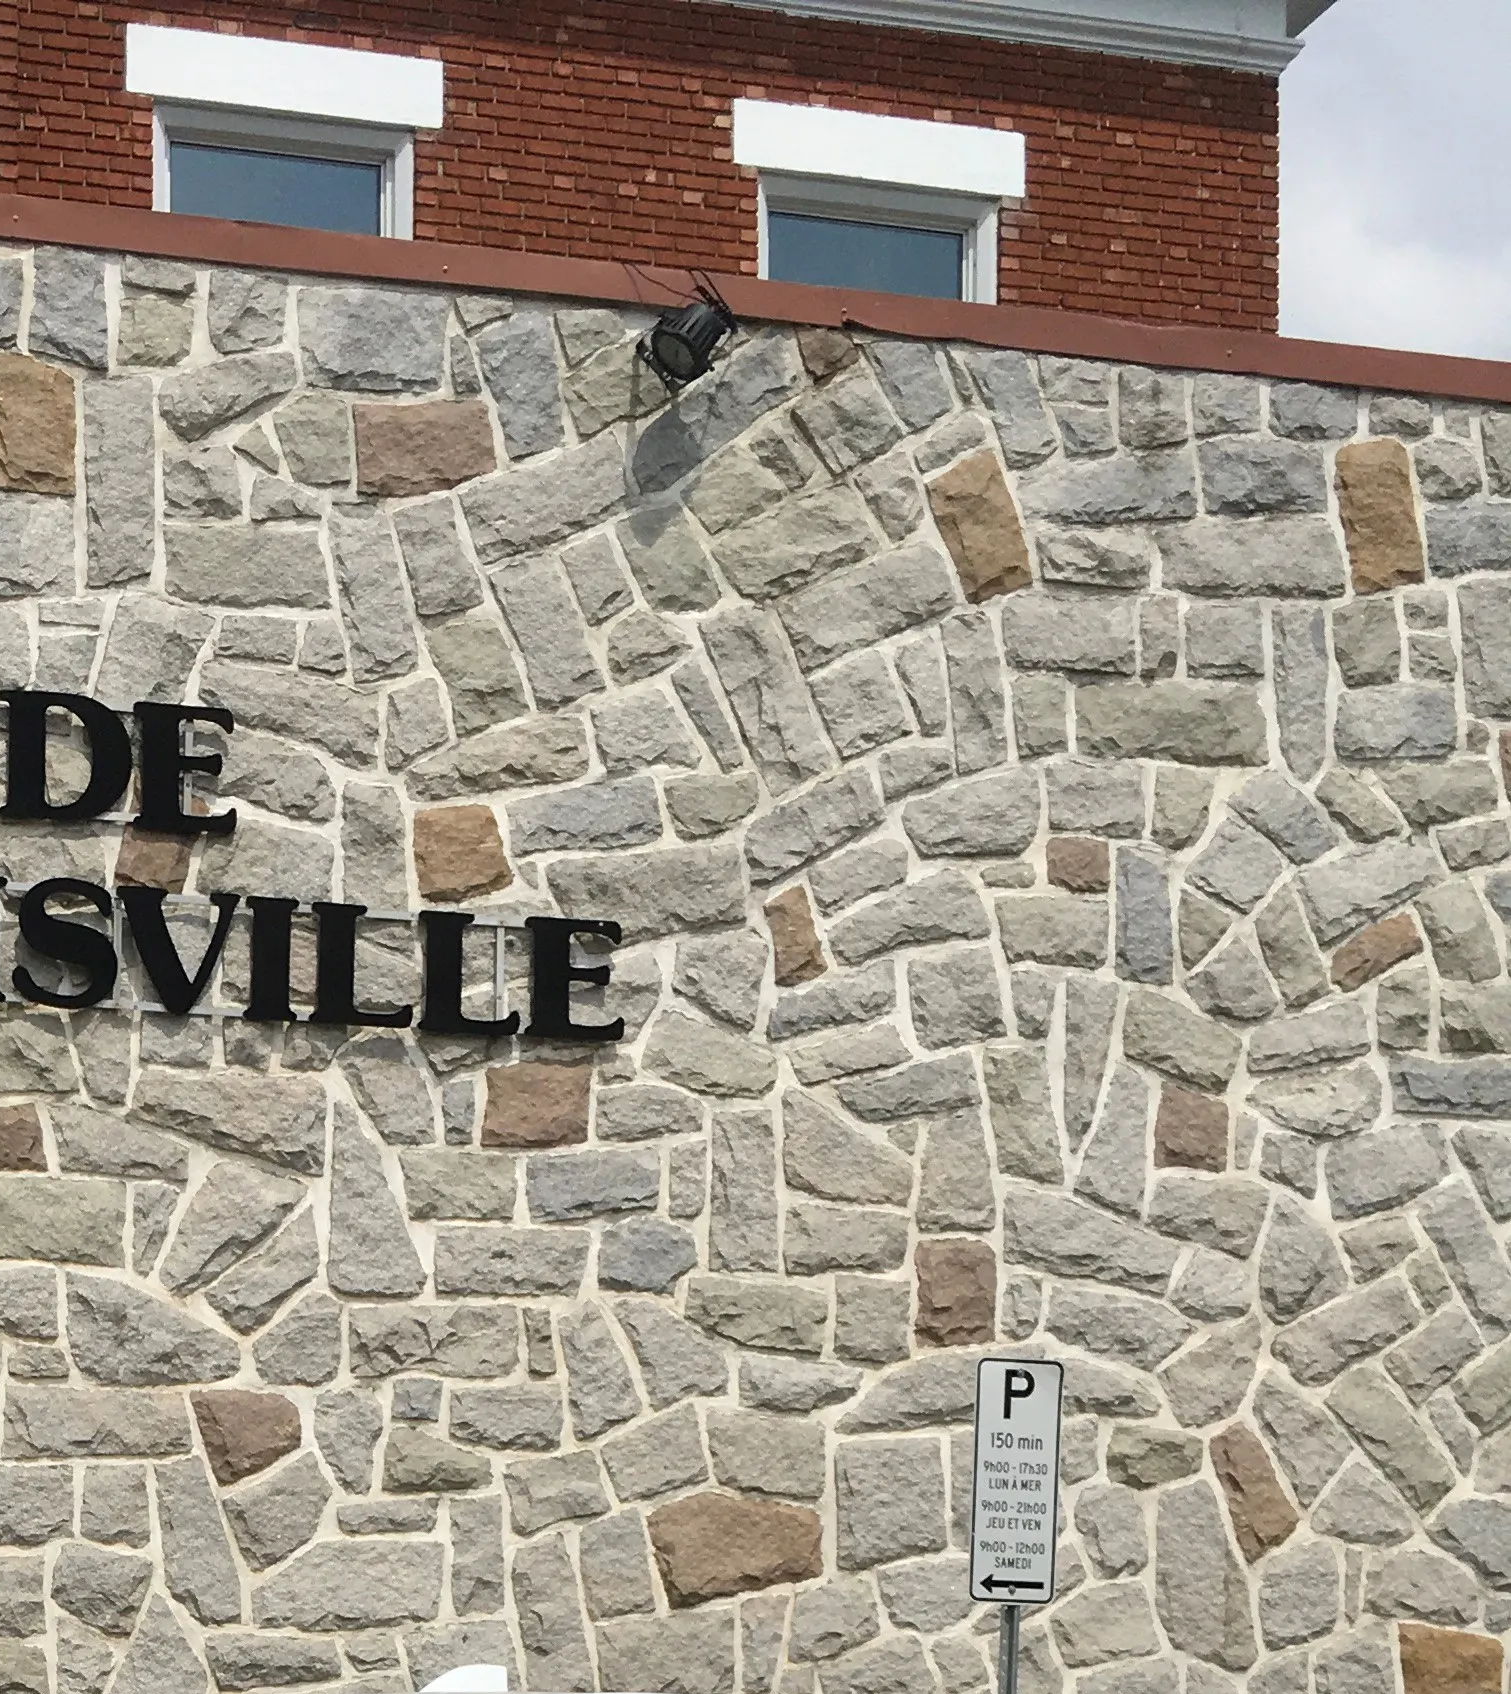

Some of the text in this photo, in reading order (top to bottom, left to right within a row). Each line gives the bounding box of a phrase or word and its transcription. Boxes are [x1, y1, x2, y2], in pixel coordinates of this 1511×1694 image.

[1003, 1368, 1035, 1419] P
[990, 1432, 1043, 1451] 150 min
[988, 1478, 1009, 1490] LUN
[1020, 1479, 1042, 1491] MER
[985, 1516, 1041, 1531] JEU ET VEN
[994, 1556, 1032, 1570] SAMEDI
